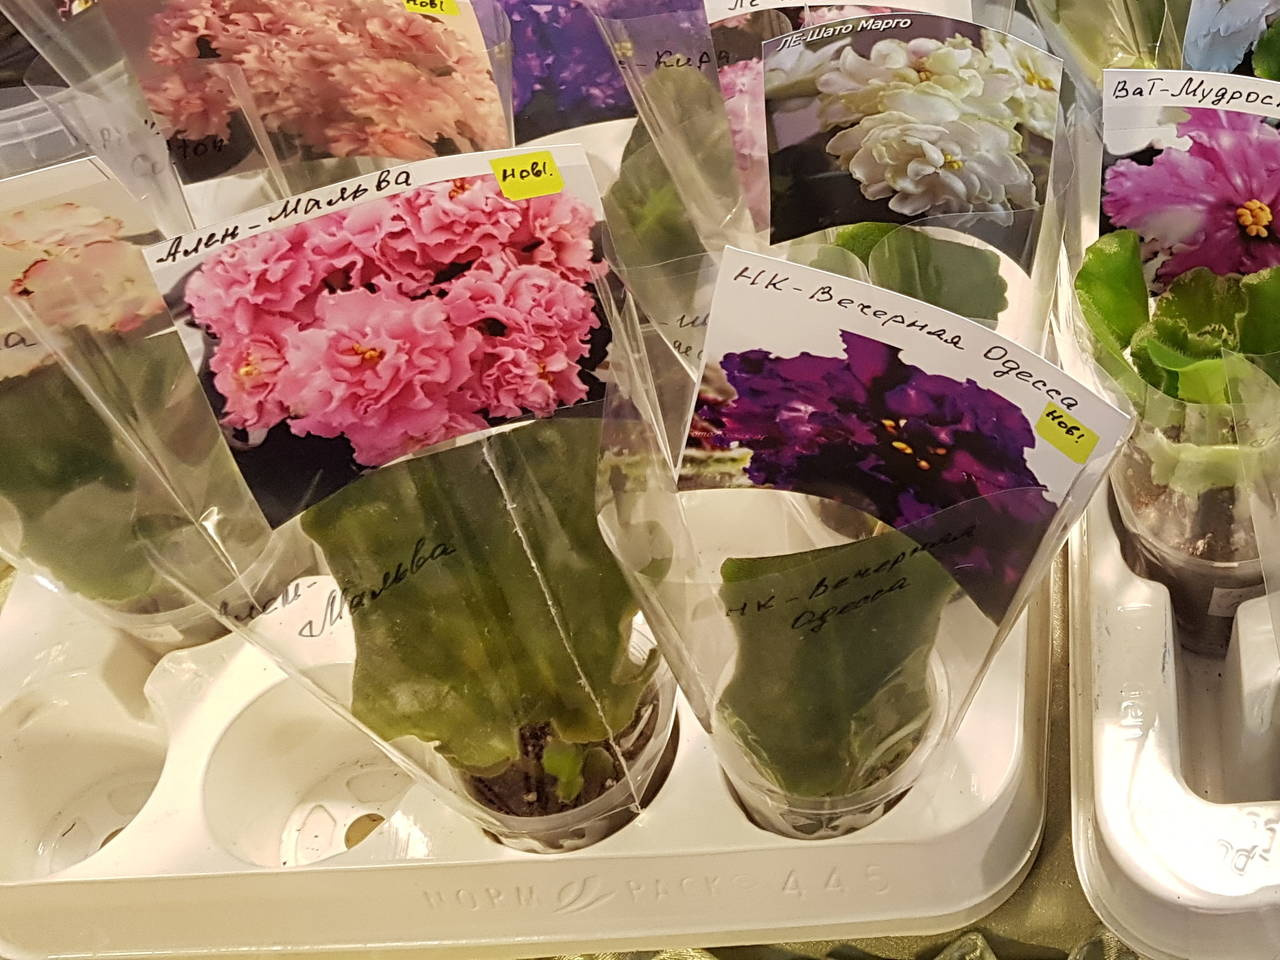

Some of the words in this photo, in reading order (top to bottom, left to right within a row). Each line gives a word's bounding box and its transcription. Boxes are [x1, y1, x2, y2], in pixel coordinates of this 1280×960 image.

[776, 22, 854, 51] ЛЕ-Шато
[857, 15, 912, 33] Марго
[983, 344, 1080, 411] Одесса
